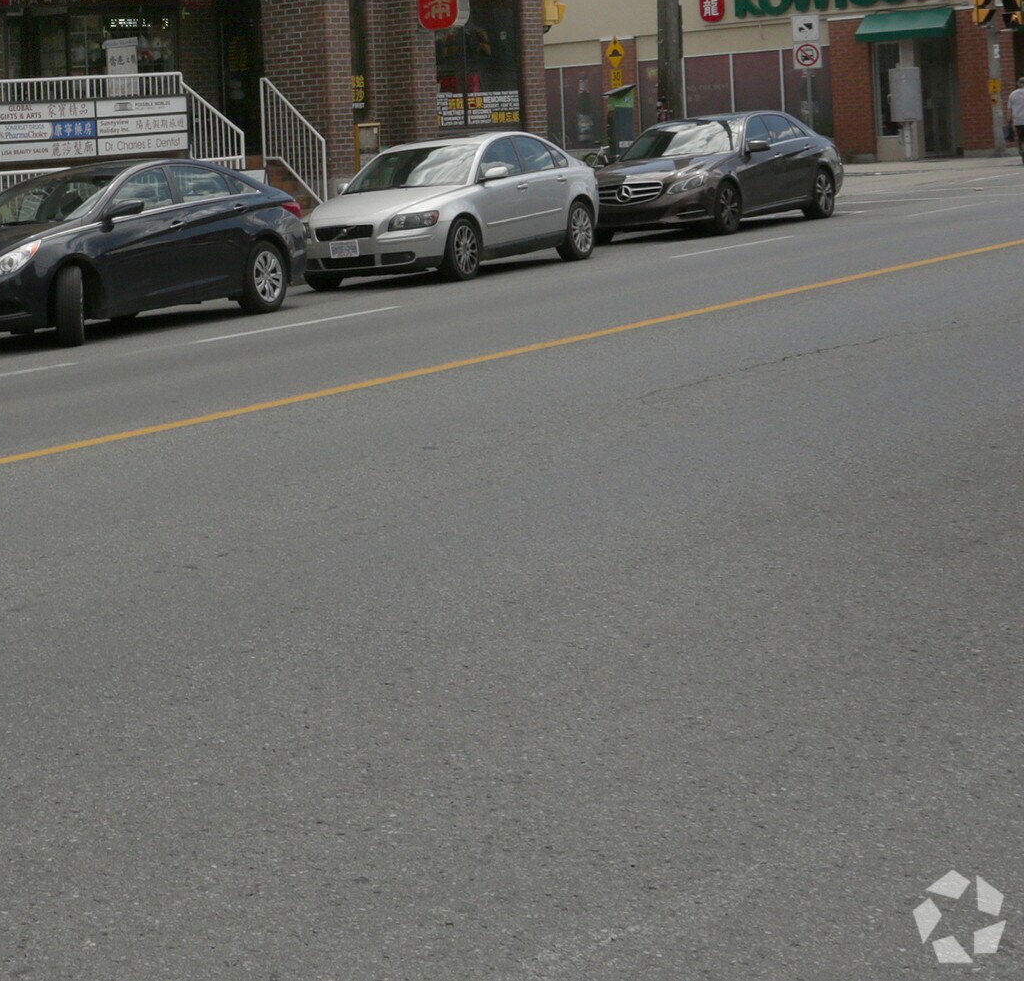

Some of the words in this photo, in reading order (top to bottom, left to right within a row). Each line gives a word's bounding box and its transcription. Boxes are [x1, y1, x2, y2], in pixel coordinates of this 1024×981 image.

[8, 103, 33, 112] GLOBAL
[100, 119, 129, 127] Sunnyview
[4, 130, 48, 139] PharmaChoice
[116, 140, 146, 151] Charles
[156, 137, 181, 148] Dentist
